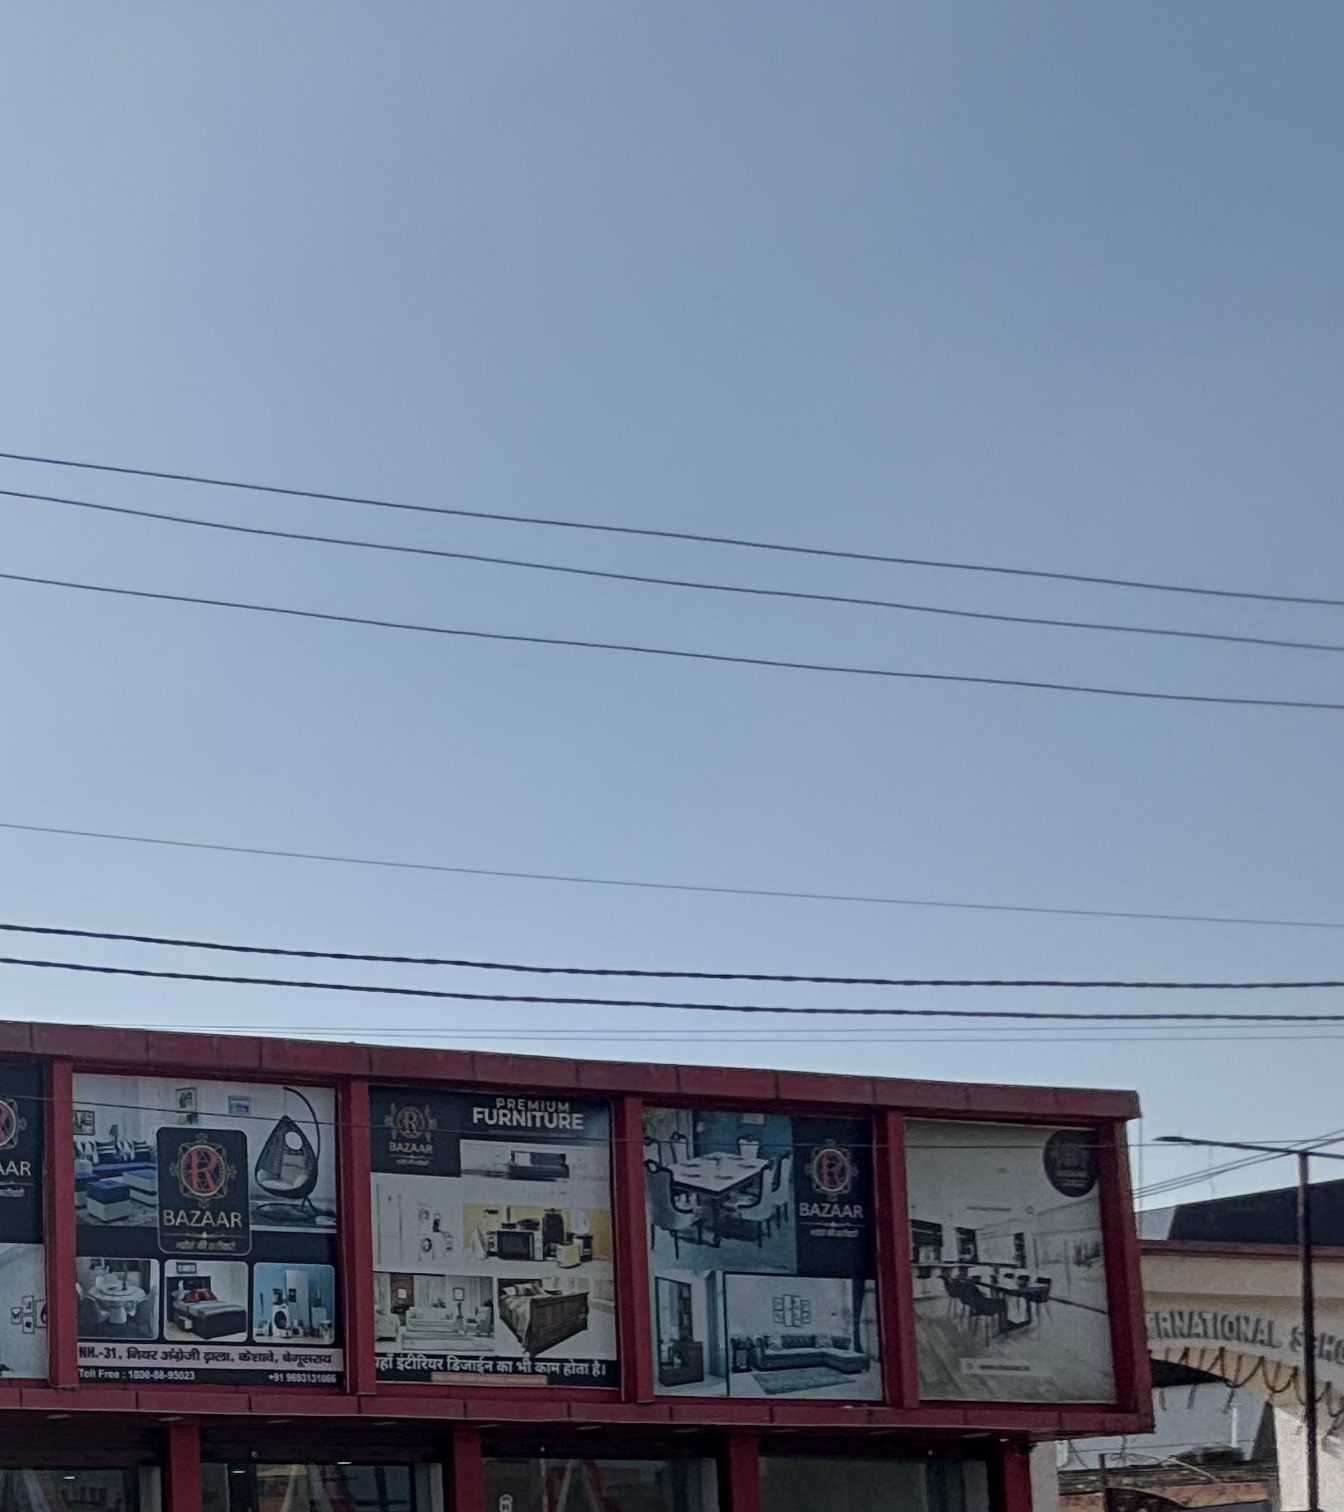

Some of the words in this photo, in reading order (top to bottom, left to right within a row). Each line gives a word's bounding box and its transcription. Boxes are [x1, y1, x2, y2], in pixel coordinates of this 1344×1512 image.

[495, 1097, 570, 1113] PREMIUM
[472, 1106, 585, 1131] FURNITURE
[389, 1141, 434, 1154] BAZAAR
[162, 1209, 243, 1229] BAZAAR
[799, 1202, 865, 1219] BAZAAR
